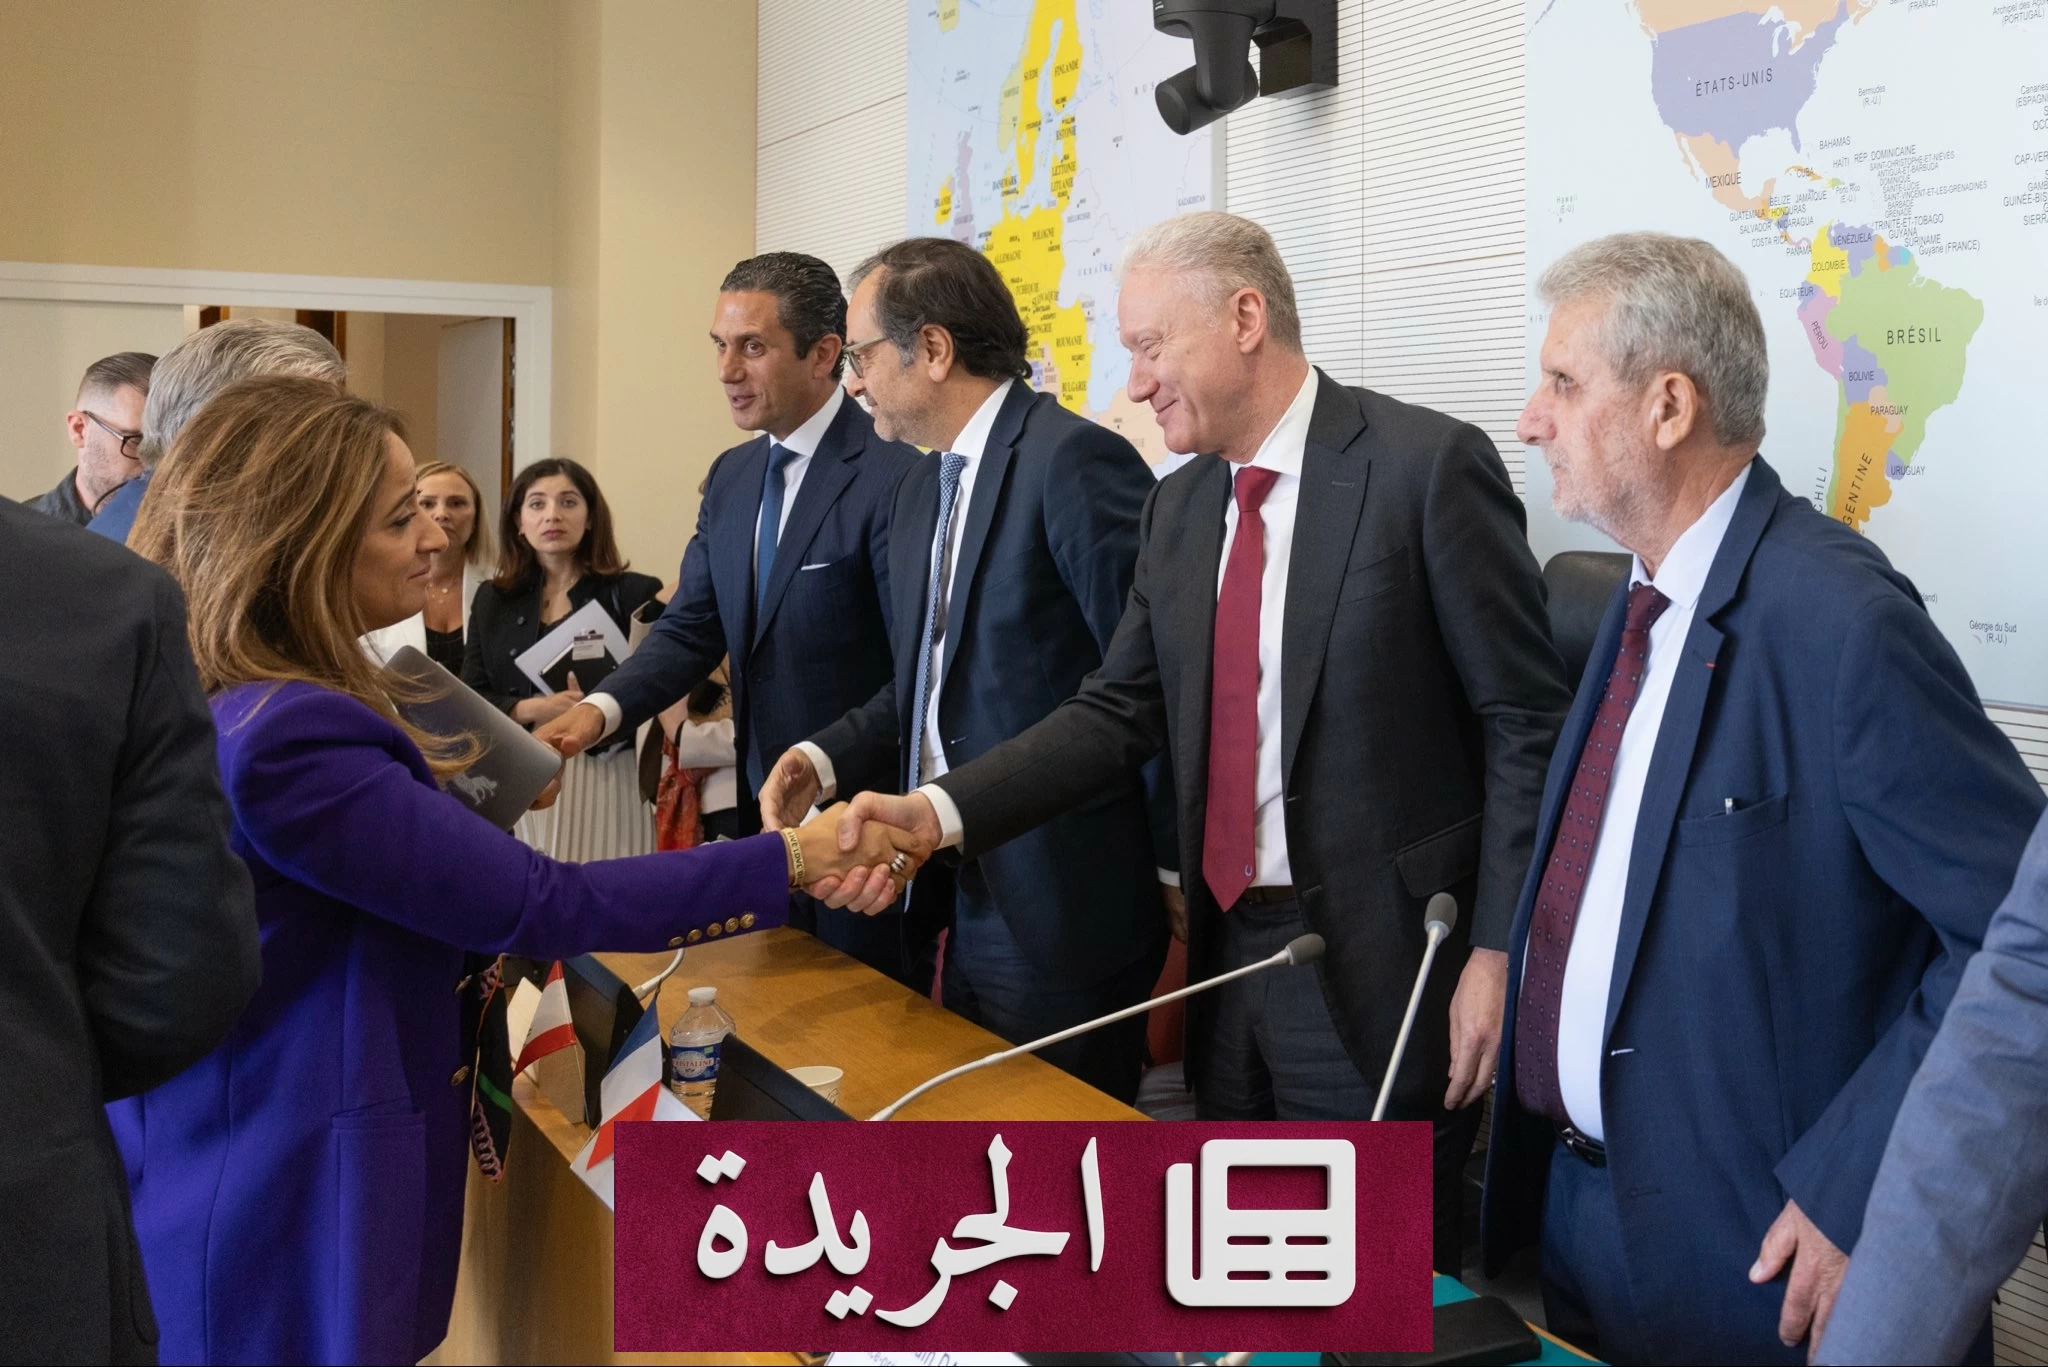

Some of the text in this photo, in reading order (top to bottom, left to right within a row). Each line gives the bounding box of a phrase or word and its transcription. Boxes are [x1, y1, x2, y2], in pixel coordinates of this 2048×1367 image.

[1696, 68, 1773, 97] ÉTATS-UNIS
[2016, 93, 2048, 108] (ESPAGN
[1819, 136, 1851, 150] BAHAMAS
[1705, 172, 1742, 189] MEXIQUE
[1729, 208, 1766, 222] GUATEMALA
[1772, 204, 1806, 217] HONDURAS
[1777, 216, 1814, 230] NICARAGUA
[2023, 213, 2048, 226] SIERR
[1739, 221, 1772, 234] SALVADOR
[1888, 227, 1918, 239] GUYANA
[1905, 234, 1941, 247] SURINAME
[1945, 239, 1981, 254] (FRANCE)
[1811, 260, 1846, 272] COLOMBIE
[1811, 320, 1829, 350] PÉROU
[1886, 325, 1942, 345] BRÉSIL
[1848, 371, 1875, 381] BOLIVIE
[1870, 405, 1909, 416] PARAGUAY
[1890, 465, 1926, 476] URUGUAY
[1813, 466, 1828, 513] CHILI
[1842, 452, 1873, 527] GENTINE
[2004, 622, 2017, 633] Sud
